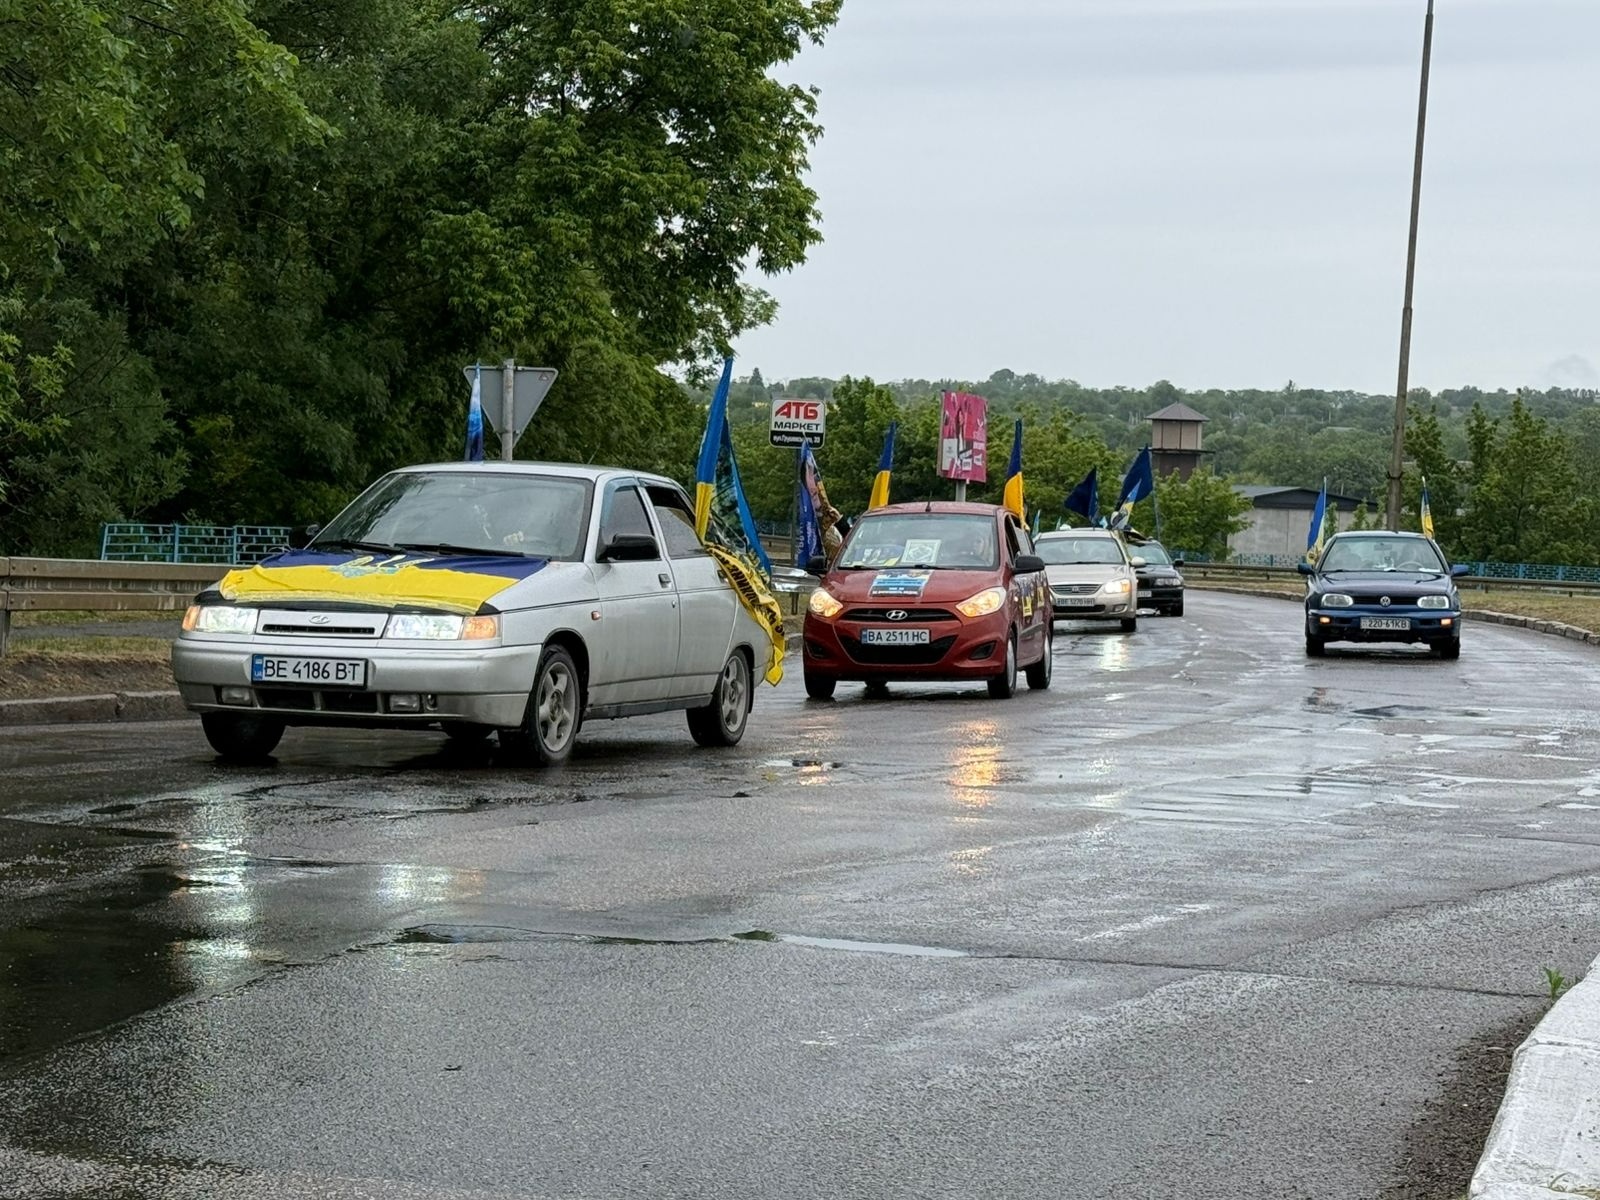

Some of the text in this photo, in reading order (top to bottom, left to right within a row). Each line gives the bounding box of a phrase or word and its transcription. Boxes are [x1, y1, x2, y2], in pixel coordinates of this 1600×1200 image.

[775, 401, 821, 420] АТБ
[774, 421, 821, 431] МАРКЕТ
[868, 631, 928, 642] BA 2511 HC
[264, 660, 361, 681] BE 4186 BT
